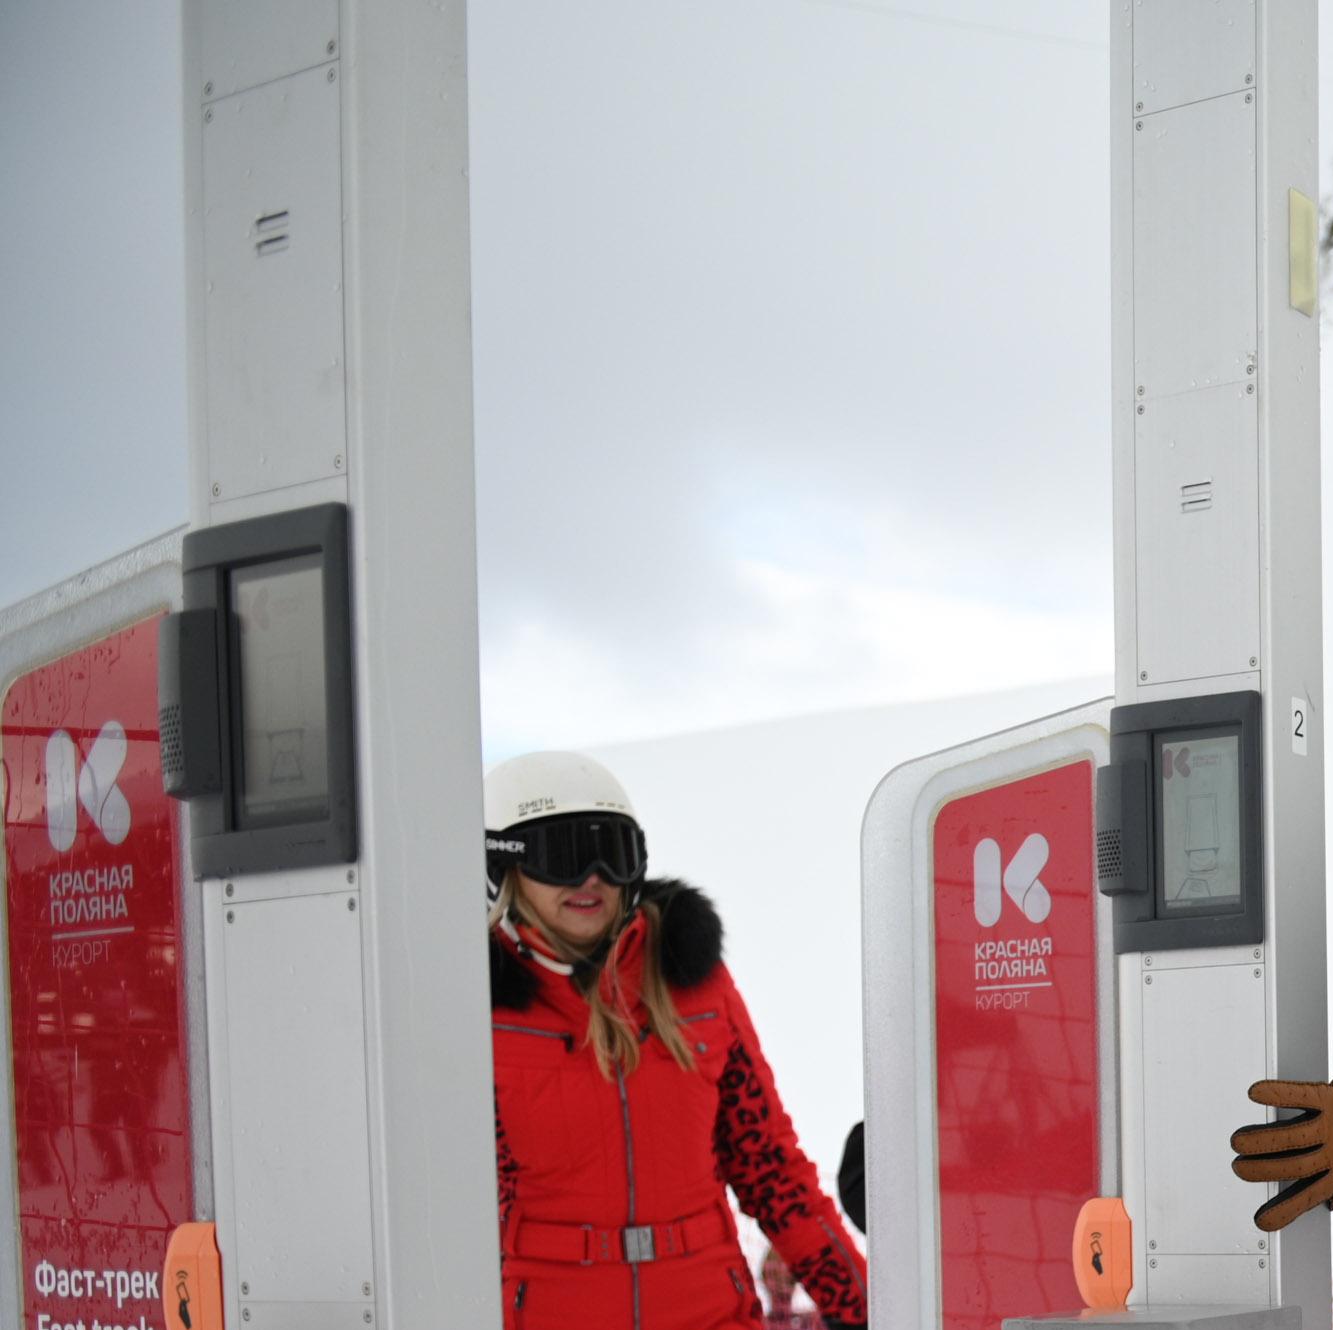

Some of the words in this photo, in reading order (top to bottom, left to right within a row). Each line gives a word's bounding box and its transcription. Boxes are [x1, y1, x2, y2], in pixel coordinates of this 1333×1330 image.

[1294, 709, 1304, 738] 2
[50, 864, 134, 897] КРАСНАЯ
[51, 893, 128, 925] ПОЛЯНА
[51, 939, 112, 967] КУРОРТ
[974, 937, 1052, 960] КРАСНАЯ
[975, 958, 1047, 980] ПОЛЯНА
[975, 991, 1030, 1010] КУРОРТ
[34, 1259, 160, 1309] Фаст-трек
